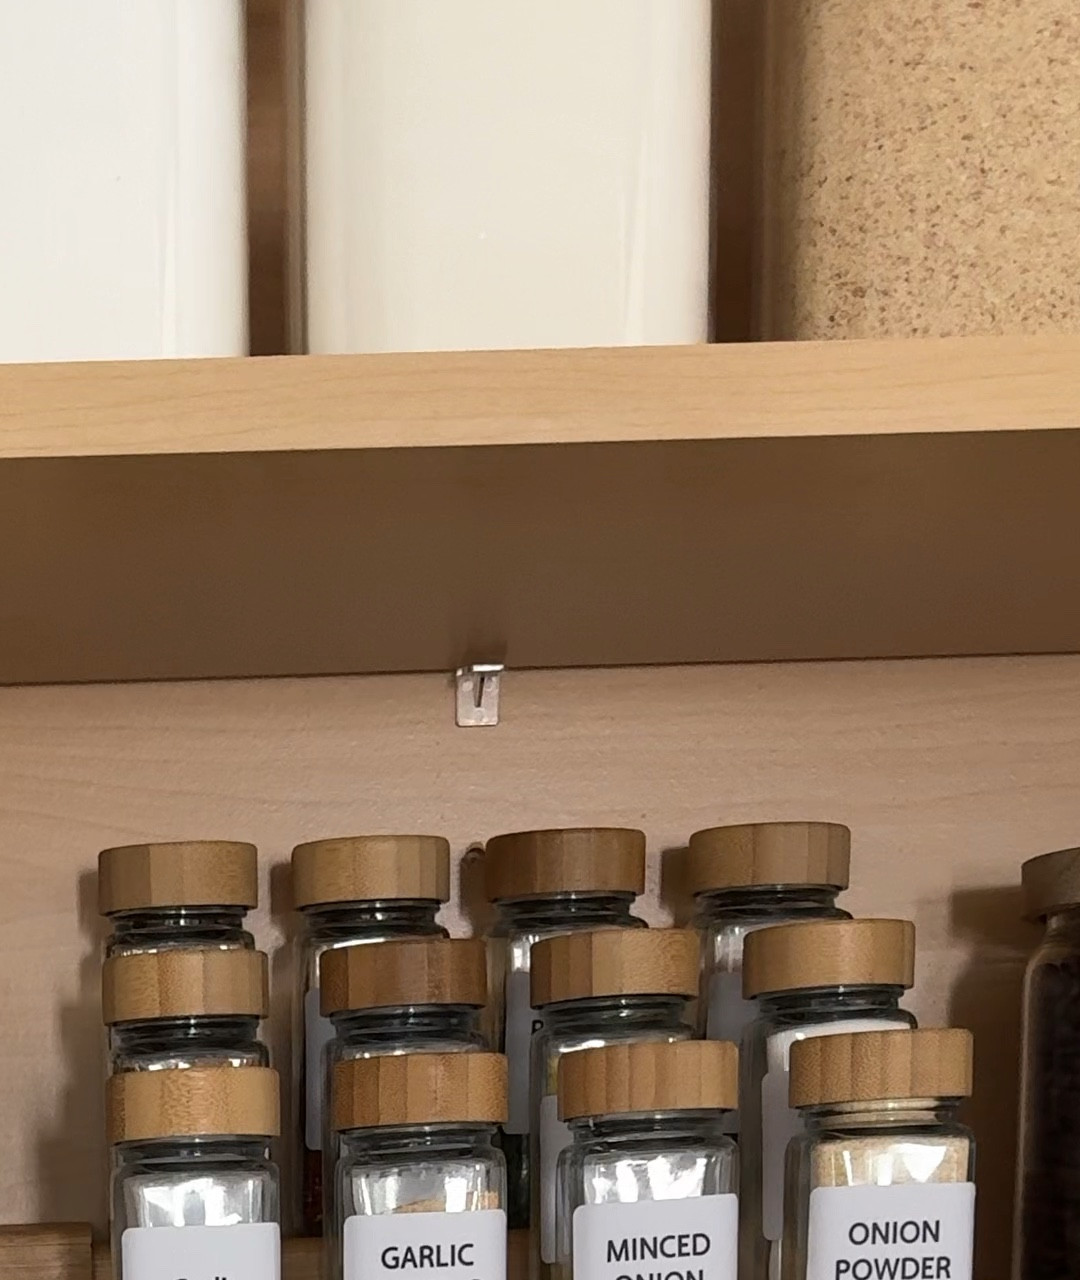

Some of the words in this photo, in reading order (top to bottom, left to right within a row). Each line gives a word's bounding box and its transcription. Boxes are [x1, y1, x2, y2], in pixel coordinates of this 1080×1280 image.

[848, 1219, 941, 1246] ONION
[380, 1242, 475, 1270] GARLIC
[606, 1232, 711, 1264] MINCED
